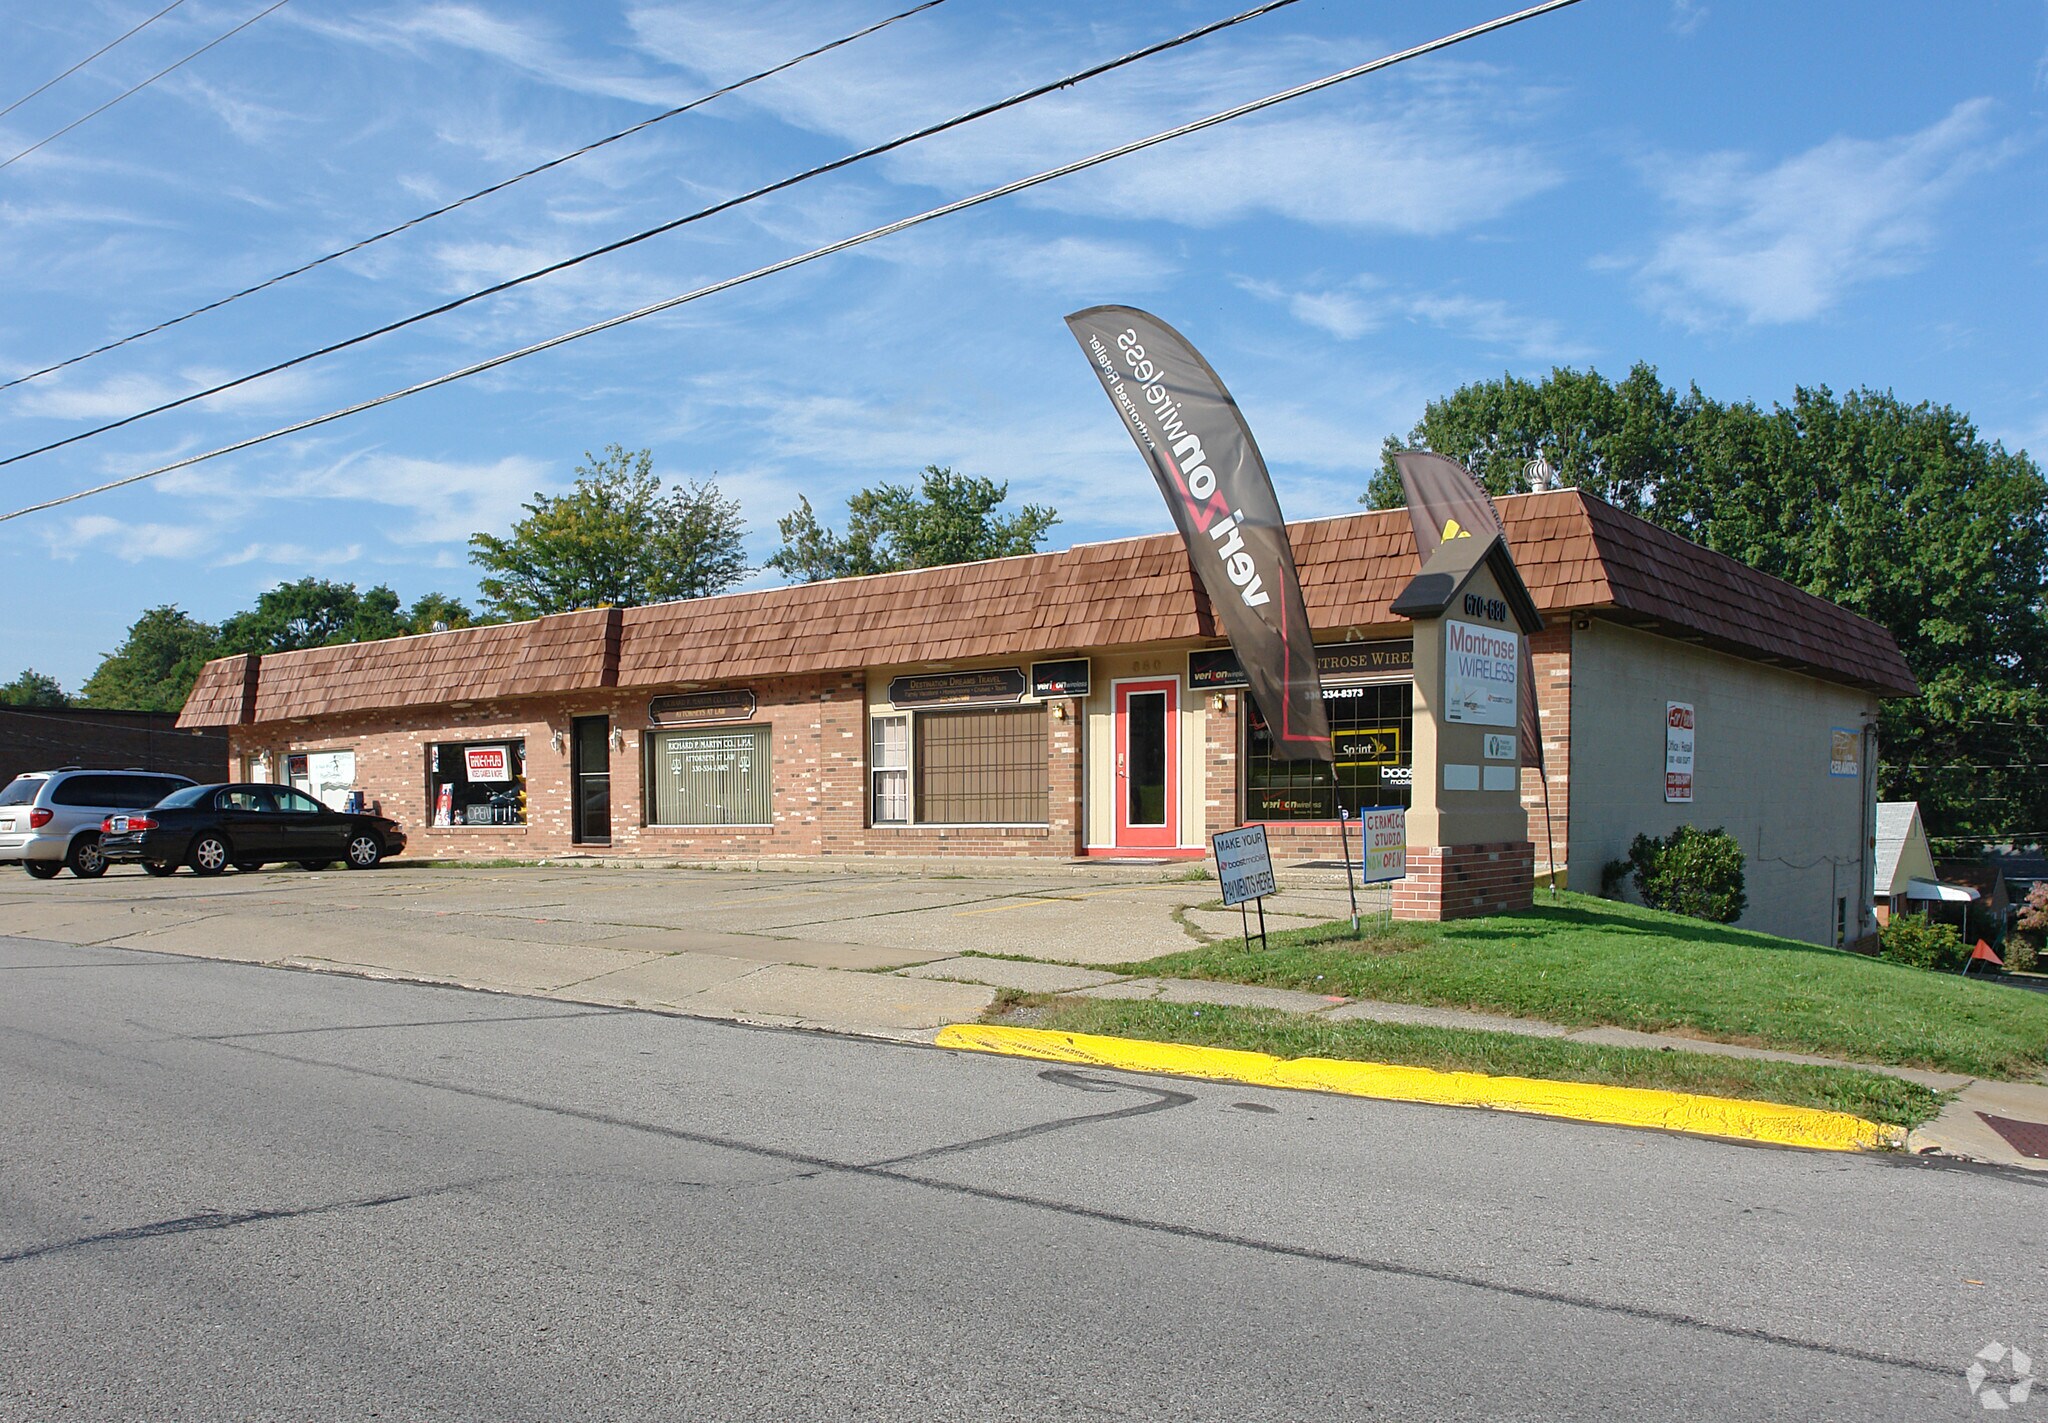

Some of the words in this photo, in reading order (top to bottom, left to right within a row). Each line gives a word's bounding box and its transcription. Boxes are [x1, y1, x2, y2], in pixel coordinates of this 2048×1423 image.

[1464, 593, 1506, 622] 670-680
[1450, 624, 1514, 660] Montrose
[1371, 652, 1413, 665] WIRE
[1459, 656, 1515, 683] WIRELESS
[1322, 689, 1363, 699] 334-8373
[676, 709, 706, 717] ATTORNEYS
[668, 742, 693, 750] RICHARD
[700, 740, 722, 748] MARTIN
[1343, 743, 1372, 758] Sprint
[686, 754, 715, 762] ATTORNEYS
[724, 753, 736, 761] LAW
[468, 806, 491, 820] OPEN
[1367, 813, 1405, 830] CERAMICS
[1217, 838, 1241, 852] MAKE
[1242, 832, 1262, 847] YOUR
[1375, 831, 1401, 846] STUDIO
[1228, 854, 1267, 870] boostmobile
[1366, 855, 1382, 870] NOW
[1383, 852, 1402, 868] OPEN
[1224, 876, 1257, 901] PAYMENTS
[1257, 871, 1273, 892] HERE
